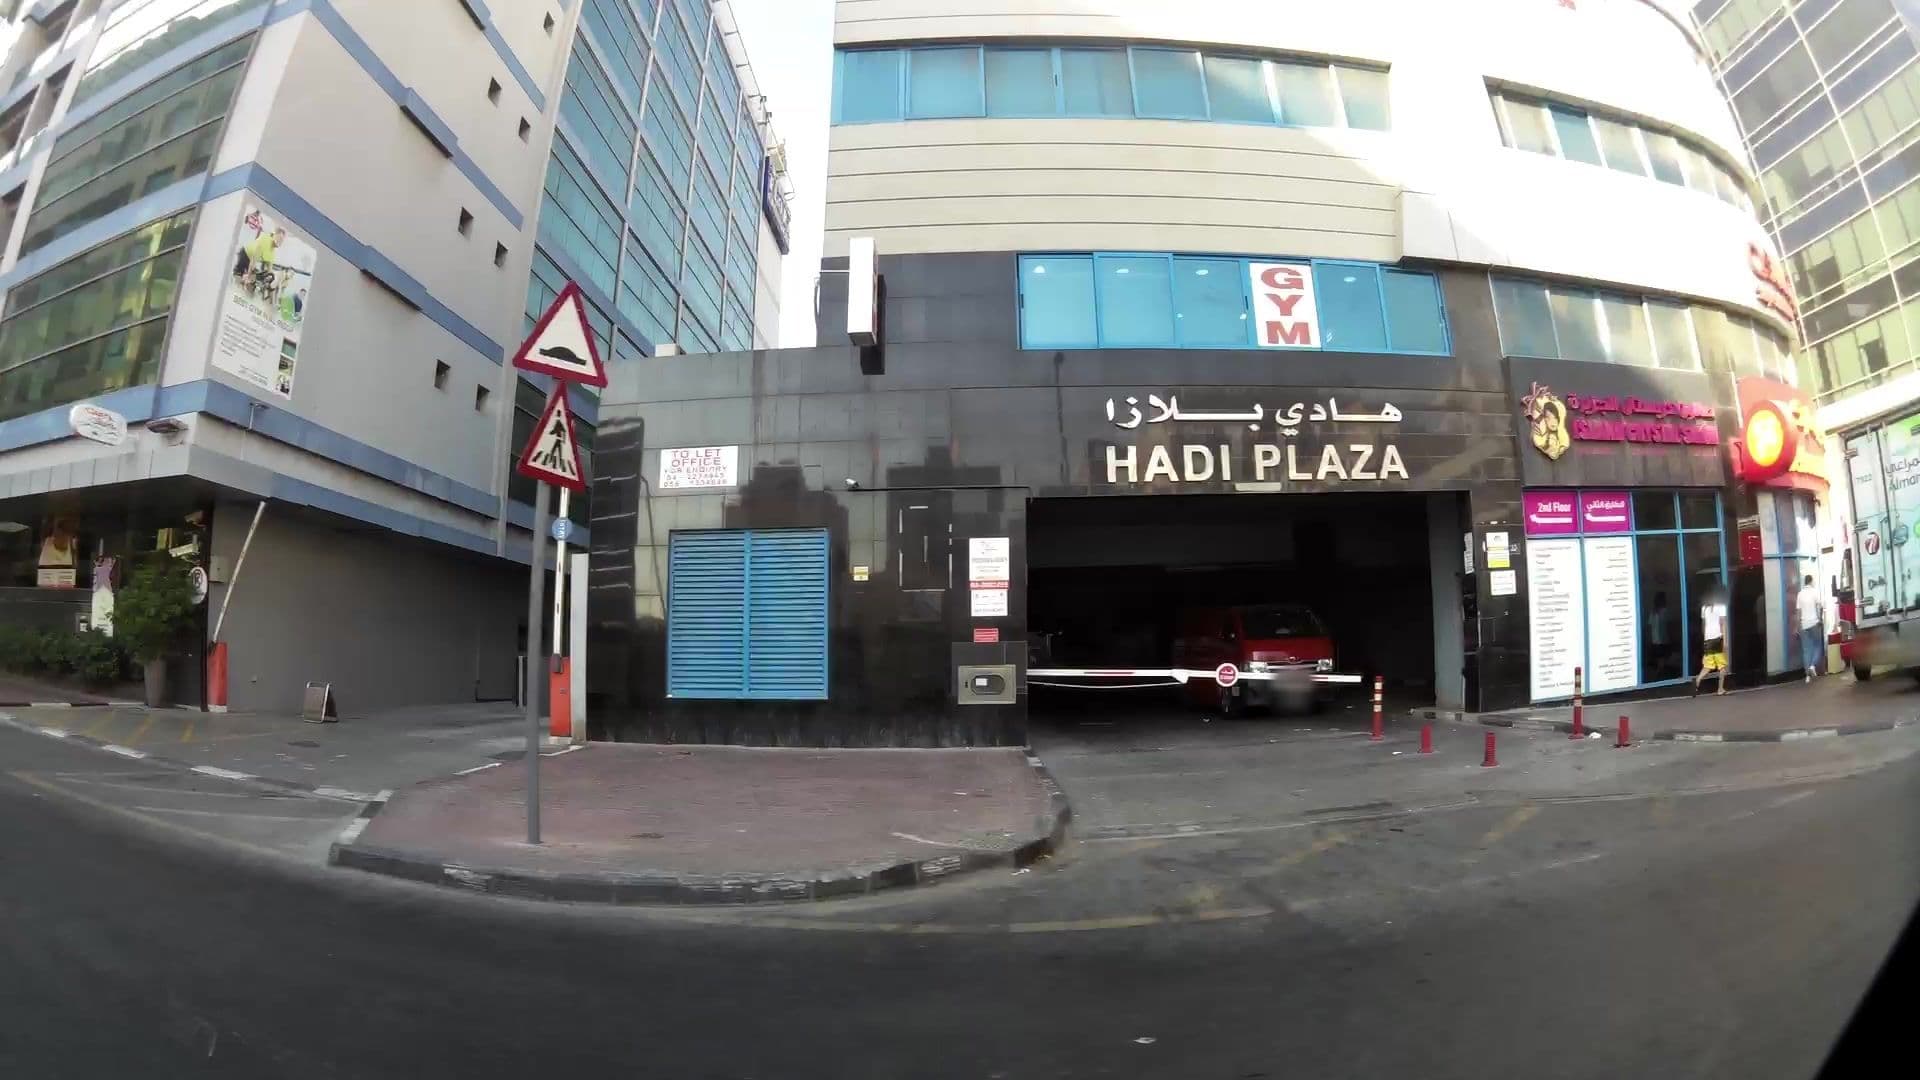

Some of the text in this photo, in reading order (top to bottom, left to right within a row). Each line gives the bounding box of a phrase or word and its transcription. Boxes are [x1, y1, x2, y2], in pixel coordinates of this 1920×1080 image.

[1261, 267, 1312, 345] GYM
[1105, 394, 1404, 437] هادي بلازا
[671, 449, 721, 459] TO LET
[671, 457, 722, 467] OFFICE
[1105, 444, 1410, 483] HADI PLAZA
[1537, 502, 1572, 513] 2nd Floor
